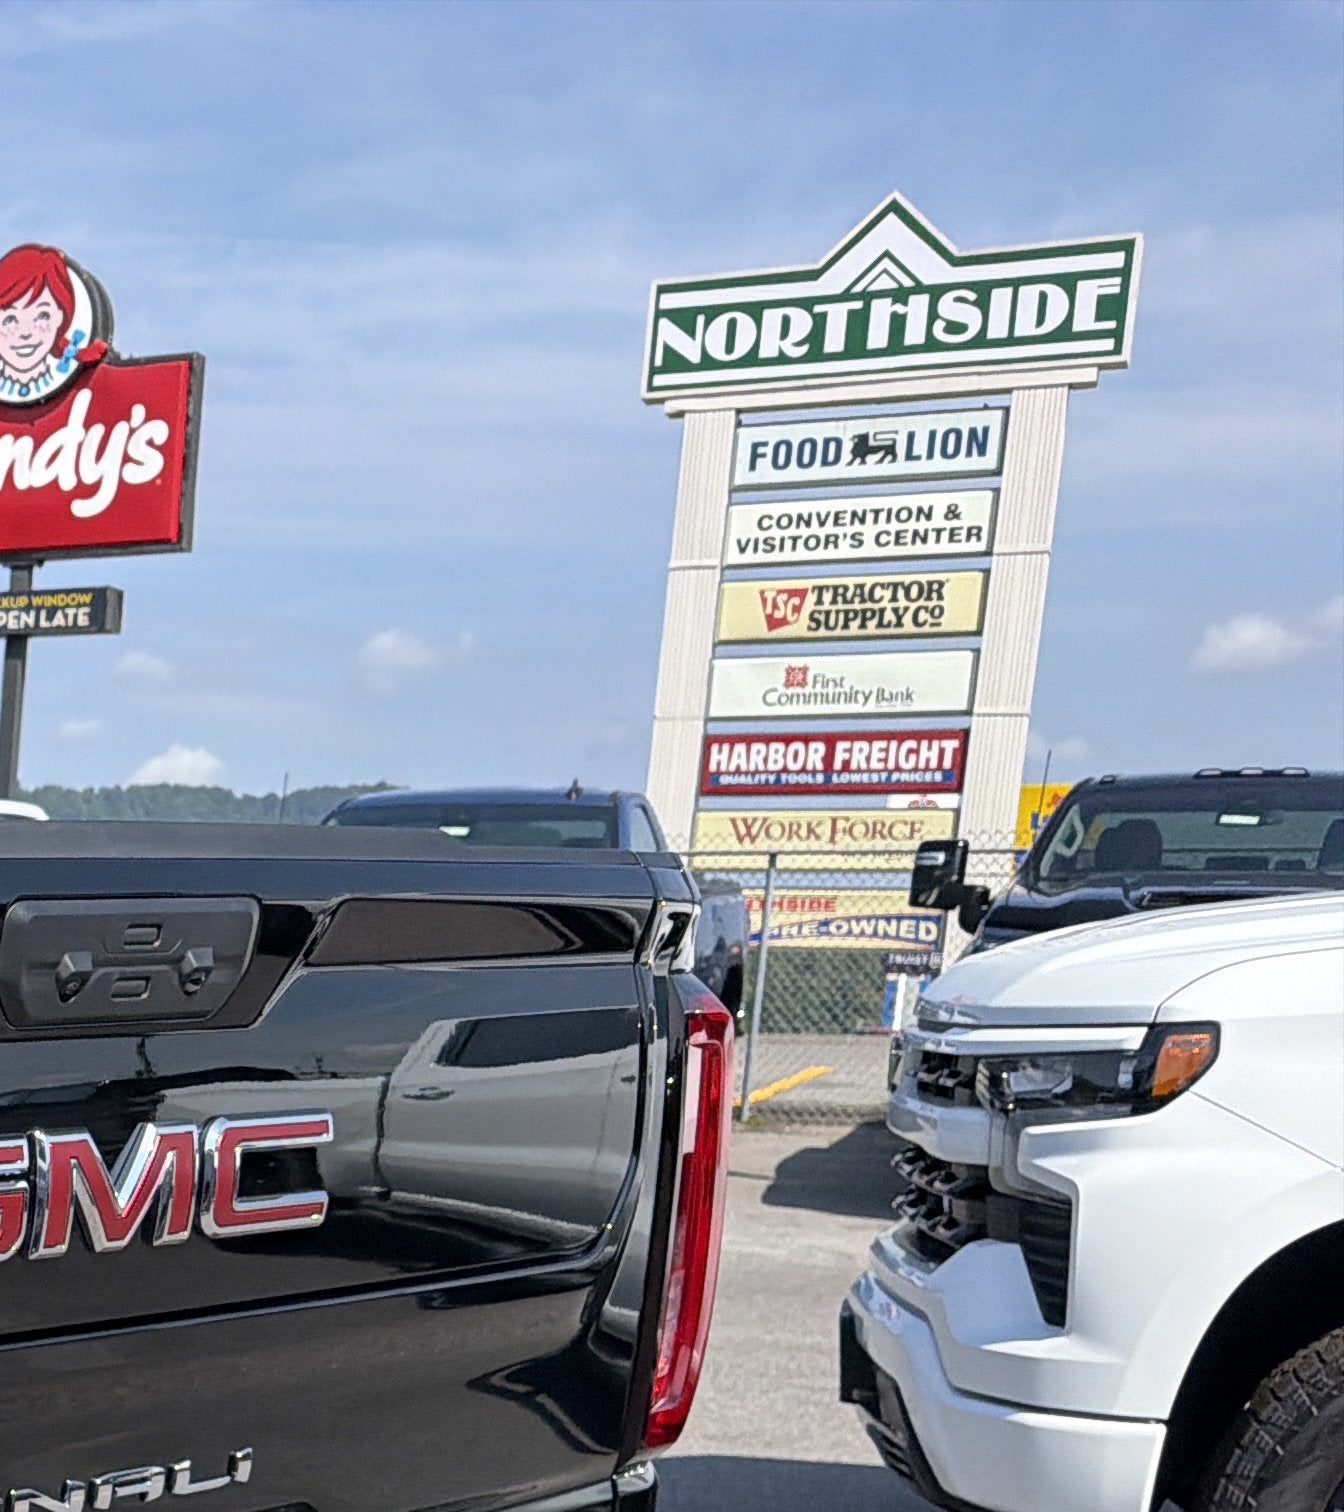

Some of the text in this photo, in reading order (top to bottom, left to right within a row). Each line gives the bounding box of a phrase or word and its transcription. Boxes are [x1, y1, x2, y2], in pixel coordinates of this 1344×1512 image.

[654, 276, 1123, 367] NORTHSIDE
[748, 425, 990, 472] FOOD LION
[757, 503, 963, 531] CONVENTION &
[736, 525, 983, 555] VISITOR'S CENTER
[31, 592, 93, 607] WINDOW
[813, 580, 946, 606] TRACTOR
[39, 606, 91, 629] LATE
[763, 591, 802, 623] TSC
[807, 605, 909, 632] SUPPLY
[812, 673, 845, 690] First
[762, 686, 914, 707] Community Bank
[709, 739, 960, 772] HARBOR FREIGHT
[718, 771, 943, 785] QUALITY TOOLS LOWEST PRICES
